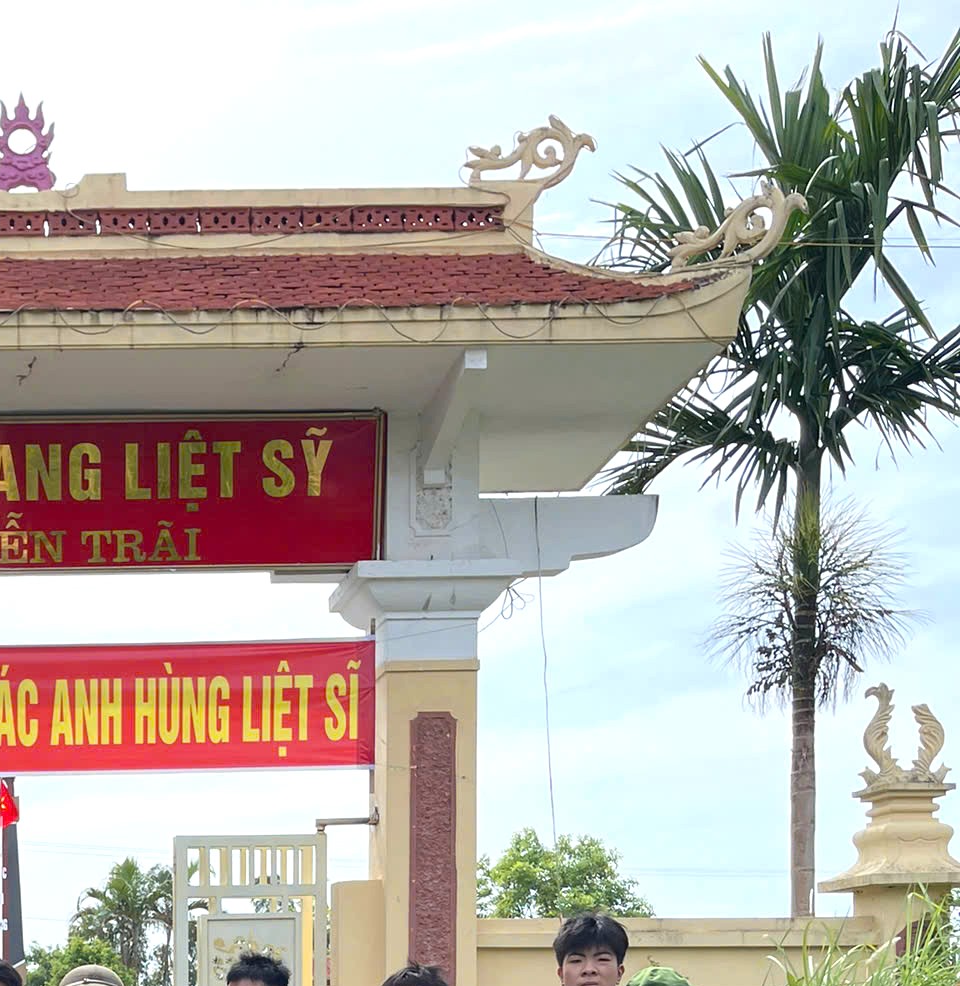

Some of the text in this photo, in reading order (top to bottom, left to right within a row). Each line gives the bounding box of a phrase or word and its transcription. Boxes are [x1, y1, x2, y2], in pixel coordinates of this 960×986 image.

[125, 430, 241, 512] LIỆT
[262, 427, 333, 498] SỸ
[81, 520, 201, 563] TRÃI
[49, 678, 123, 747] ANH
[134, 661, 231, 746] HÙNG
[241, 659, 314, 758] LIỆT
[323, 659, 361, 743] SĨ
